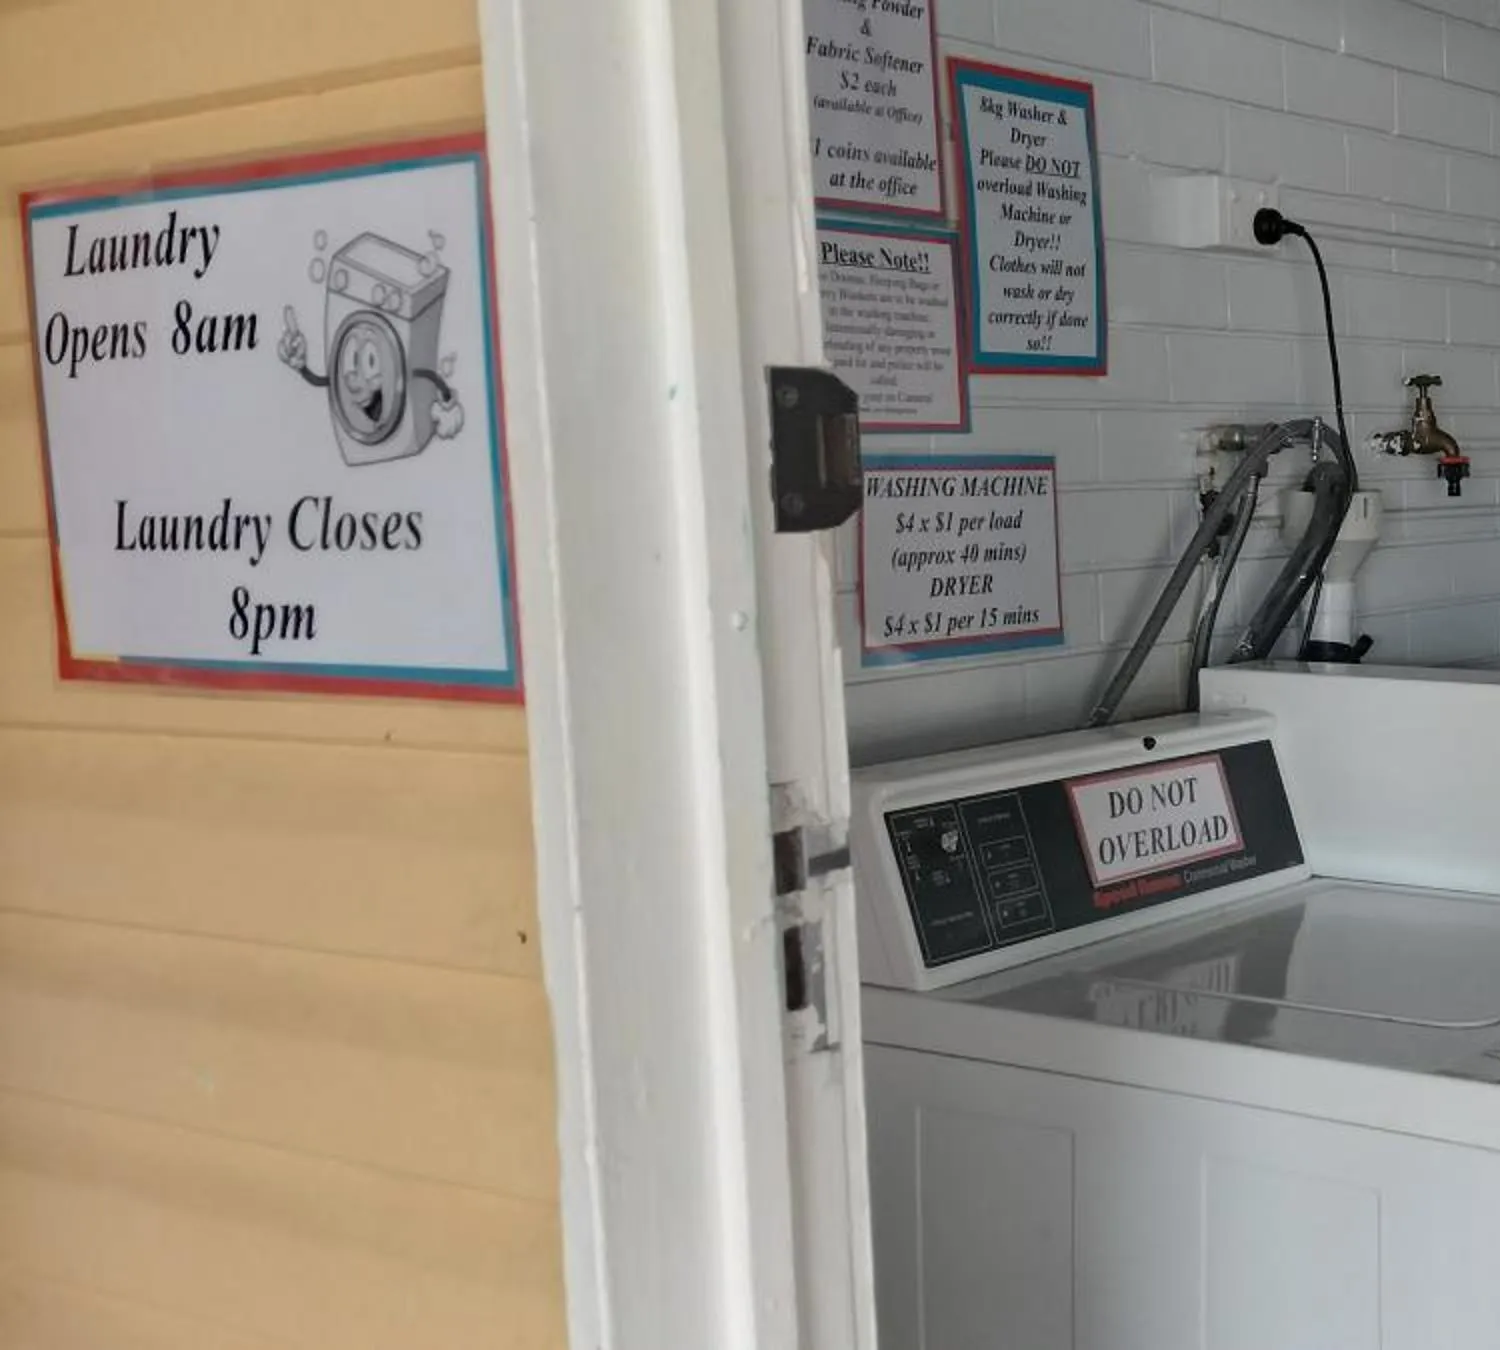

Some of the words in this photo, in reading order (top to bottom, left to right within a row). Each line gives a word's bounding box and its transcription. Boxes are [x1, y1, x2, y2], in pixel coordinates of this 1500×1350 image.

[859, 17, 873, 37] &
[806, 36, 860, 62] Fabric
[863, 50, 924, 75] Softener
[864, 79, 897, 97] each
[979, 96, 1002, 117] 8kg
[1007, 101, 1052, 124] Washer
[1056, 109, 1068, 125] &
[1010, 128, 1047, 148] Dryer
[827, 141, 870, 162] coins
[874, 147, 937, 172] available
[980, 149, 1021, 170] Please
[1026, 154, 1048, 175] DO
[1051, 159, 1081, 178] NOT
[829, 172, 846, 187] at
[850, 170, 875, 190] the
[878, 174, 919, 197] office
[977, 176, 1033, 197] overload
[1036, 183, 1087, 206] Washing
[1001, 204, 1056, 224] Machine
[1059, 213, 1072, 225] or
[64, 212, 220, 278] Laundry
[1014, 231, 1061, 253] Dryer!!
[820, 241, 875, 268] Please
[880, 247, 931, 274] Note!!
[989, 254, 1037, 275] Clothes
[1041, 259, 1063, 276] will
[1065, 263, 1086, 277] not
[1003, 280, 1034, 300] wash
[1037, 287, 1053, 301] or
[1055, 285, 1075, 306] dry
[988, 308, 1046, 330] correctly
[1048, 311, 1058, 331] if
[1059, 310, 1088, 329] done
[45, 310, 148, 378] Opens
[171, 300, 259, 355] 8am
[867, 477, 955, 497] WASHING
[960, 476, 1048, 497] MACHINE
[115, 499, 272, 567] Laundry
[288, 496, 424, 552] Closes
[896, 512, 915, 534] $4
[918, 519, 930, 532] x
[935, 512, 953, 532] $1
[958, 517, 986, 536] per
[989, 509, 1023, 530] load
[891, 549, 956, 572] (approx
[960, 544, 979, 564] 40
[983, 543, 1027, 564] mins)
[930, 575, 993, 598] DRYER
[229, 586, 317, 655] 8pm
[884, 614, 904, 638] $4
[907, 621, 918, 636] x
[924, 612, 941, 634] $1
[947, 614, 974, 636] per
[980, 607, 998, 628] 15
[1003, 605, 1039, 626] mins
[1108, 785, 1144, 819] DO
[1150, 777, 1199, 813] NOT
[1100, 814, 1229, 865] OVERLOAD
